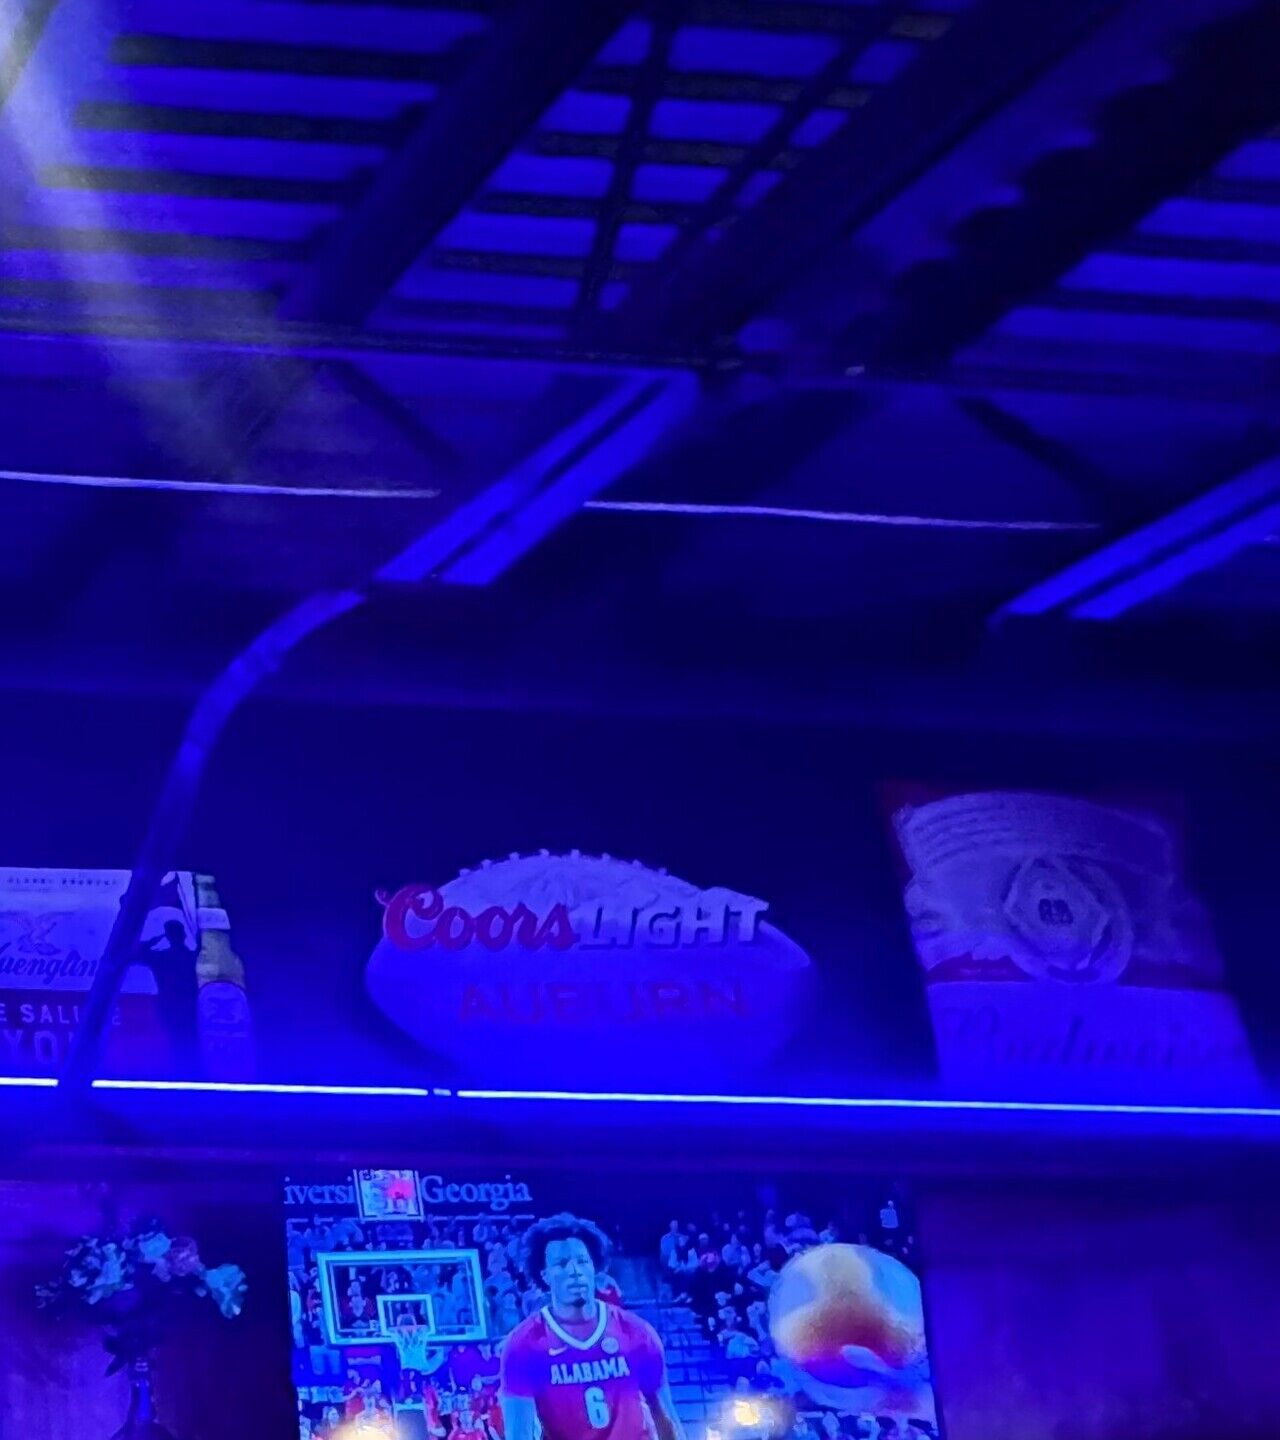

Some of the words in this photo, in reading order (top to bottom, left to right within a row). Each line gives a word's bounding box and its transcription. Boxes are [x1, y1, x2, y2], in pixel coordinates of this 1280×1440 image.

[374, 884, 579, 952] Coors
[578, 898, 770, 950] LIGHT
[3, 1029, 74, 1065] YO
[421, 1174, 533, 1211] Georgia
[550, 1356, 630, 1384] ALABAMA
[584, 1387, 609, 1429] 6
